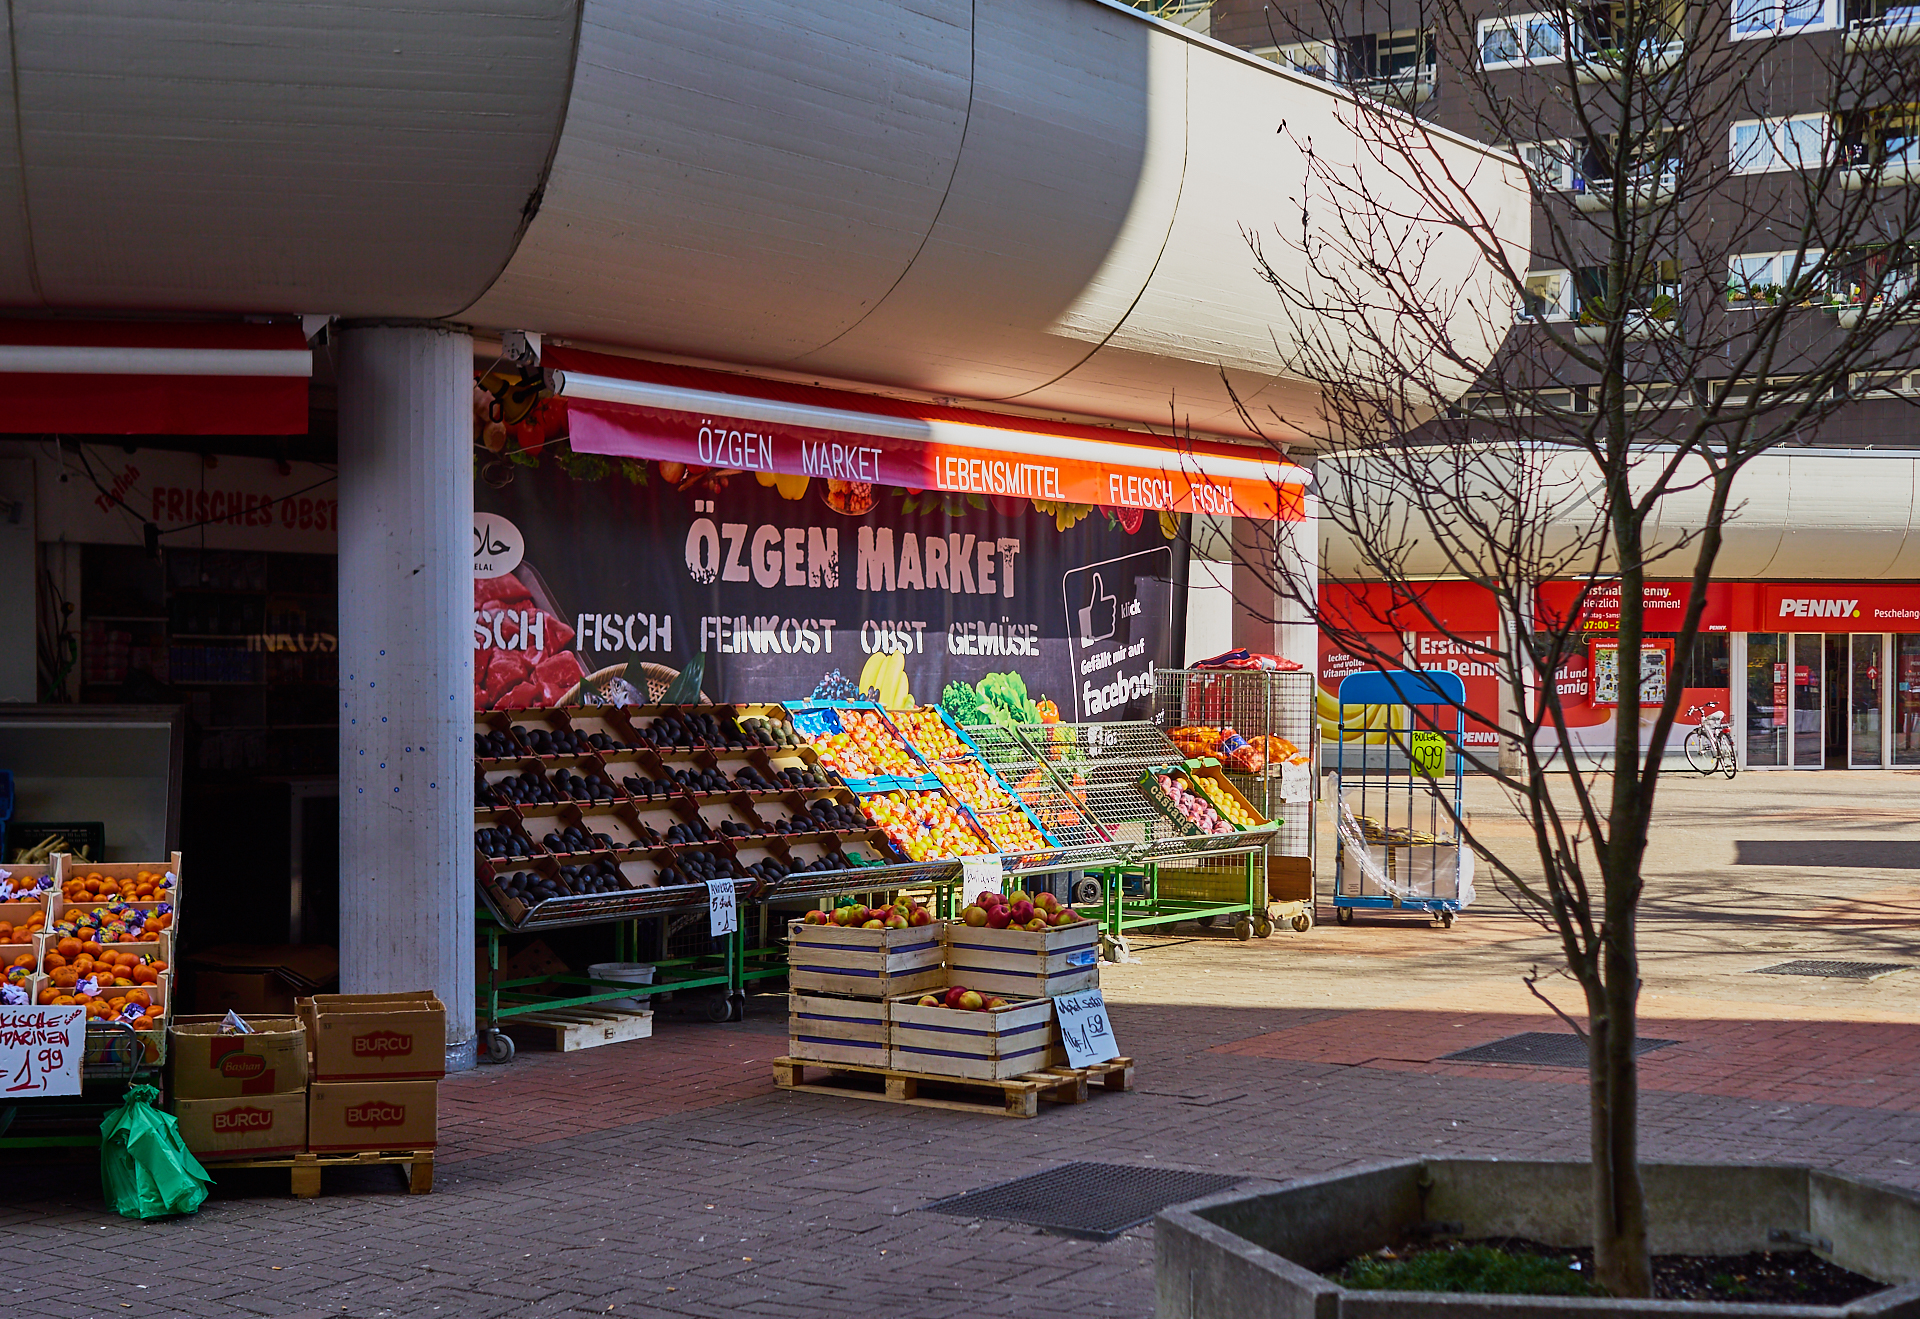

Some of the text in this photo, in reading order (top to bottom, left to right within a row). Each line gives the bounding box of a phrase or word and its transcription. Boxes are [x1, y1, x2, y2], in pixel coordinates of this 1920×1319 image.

[698, 419, 882, 481] ÖZGEN MARKET
[935, 455, 1065, 499] LEBENSMITTEL
[95, 463, 141, 513] Täglich
[1109, 474, 1235, 514] FLEISCH FISCH
[153, 486, 338, 531] FRISCHES OBST
[685, 499, 1020, 598] ÖZGEN MARKET
[474, 563, 493, 571] ELAL
[1583, 586, 1671, 598] rstmal enny.
[1121, 598, 1142, 619] klick
[1583, 599, 1681, 608] Herzlich ommen!
[577, 612, 672, 652] FISCH
[1583, 621, 1609, 629] 07:00
[701, 615, 1040, 656] FEINKOST OBST GEMÜSE
[1420, 636, 1491, 655] Erstmal
[1081, 637, 1145, 676] Gefällt mir auf
[1328, 653, 1350, 662] lecker
[1344, 659, 1365, 667] volle
[1569, 667, 1588, 678] und
[1556, 680, 1588, 695] emig
[1150, 785, 1195, 834] castang
[355, 1037, 411, 1052] BURCU
[215, 1112, 271, 1129] BURCU
[347, 1107, 403, 1123] BURCU
